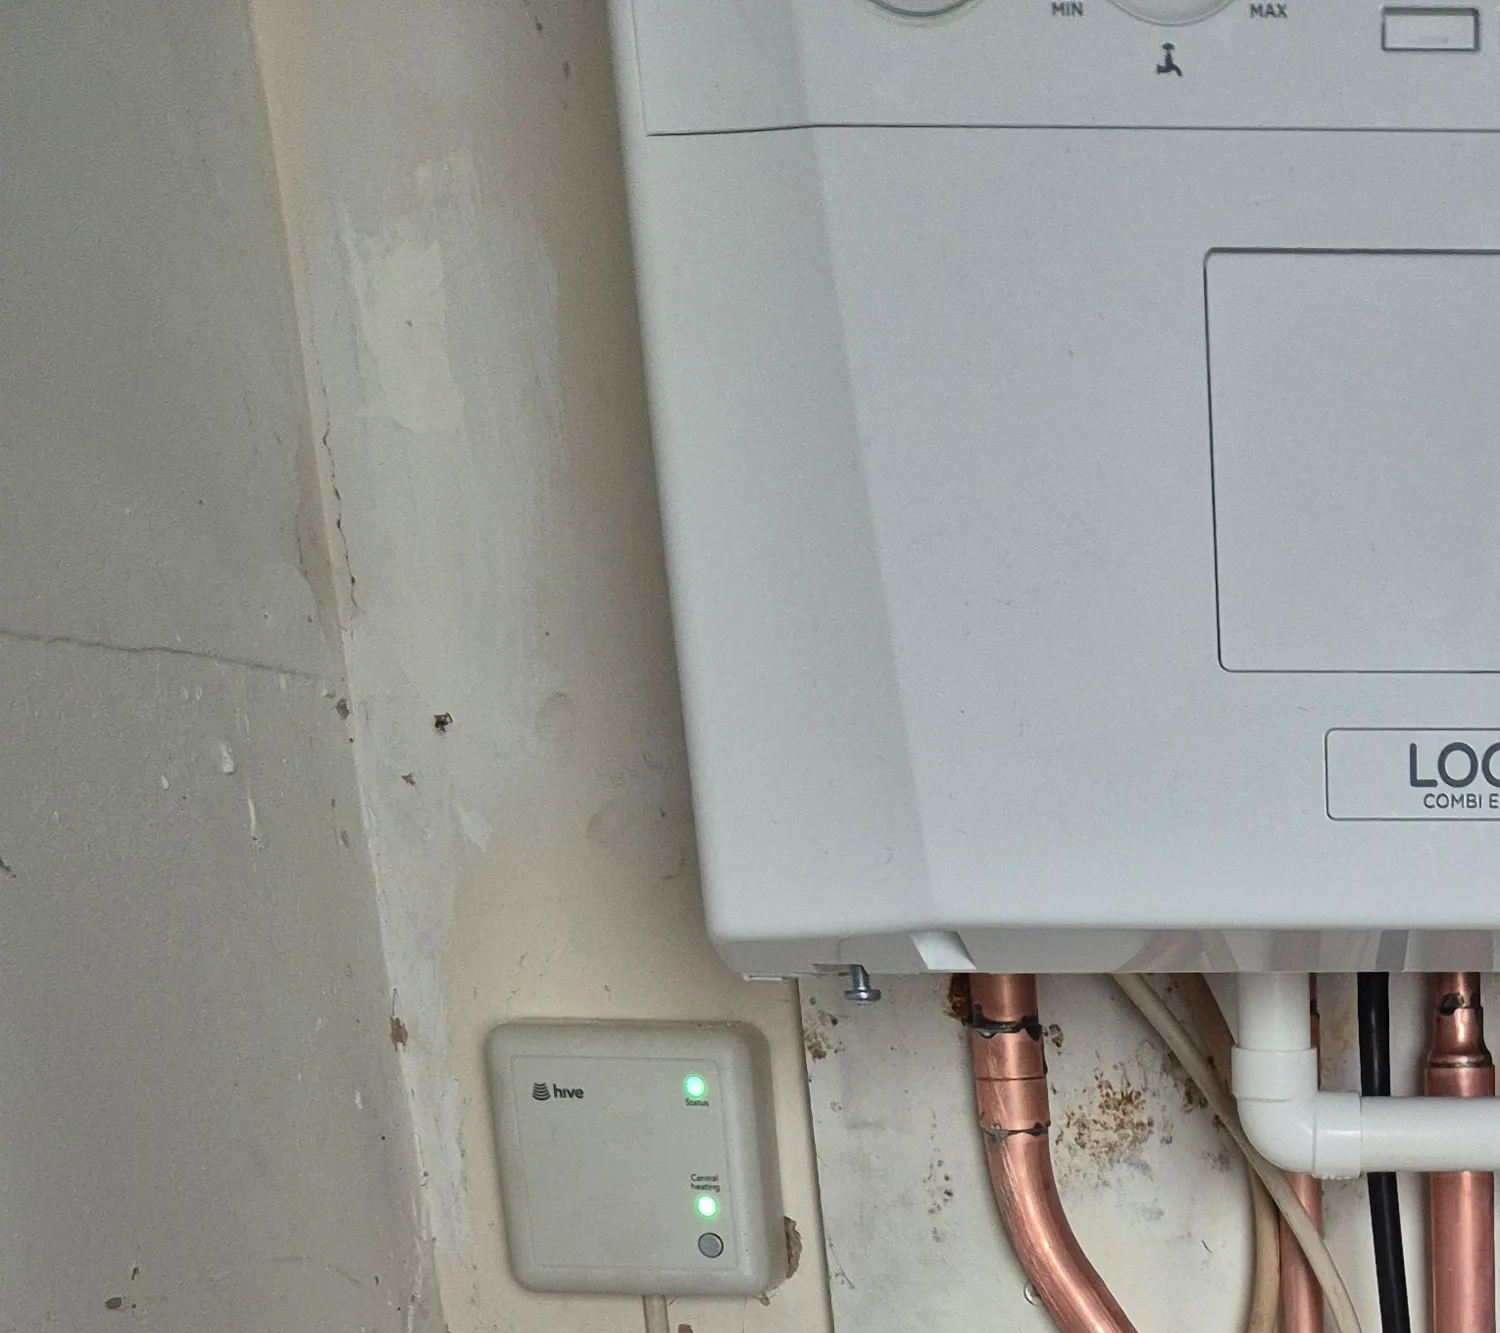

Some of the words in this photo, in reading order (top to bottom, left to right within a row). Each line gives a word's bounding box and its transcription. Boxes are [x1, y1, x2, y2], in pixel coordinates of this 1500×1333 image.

[1051, 2, 1084, 18] MIN
[1250, 3, 1289, 20] MAX
[1423, 793, 1483, 809] COMBI
[553, 1084, 584, 1099] hive
[685, 1098, 710, 1107] Status
[690, 1174, 719, 1182] Central
[690, 1183, 721, 1193] heating
